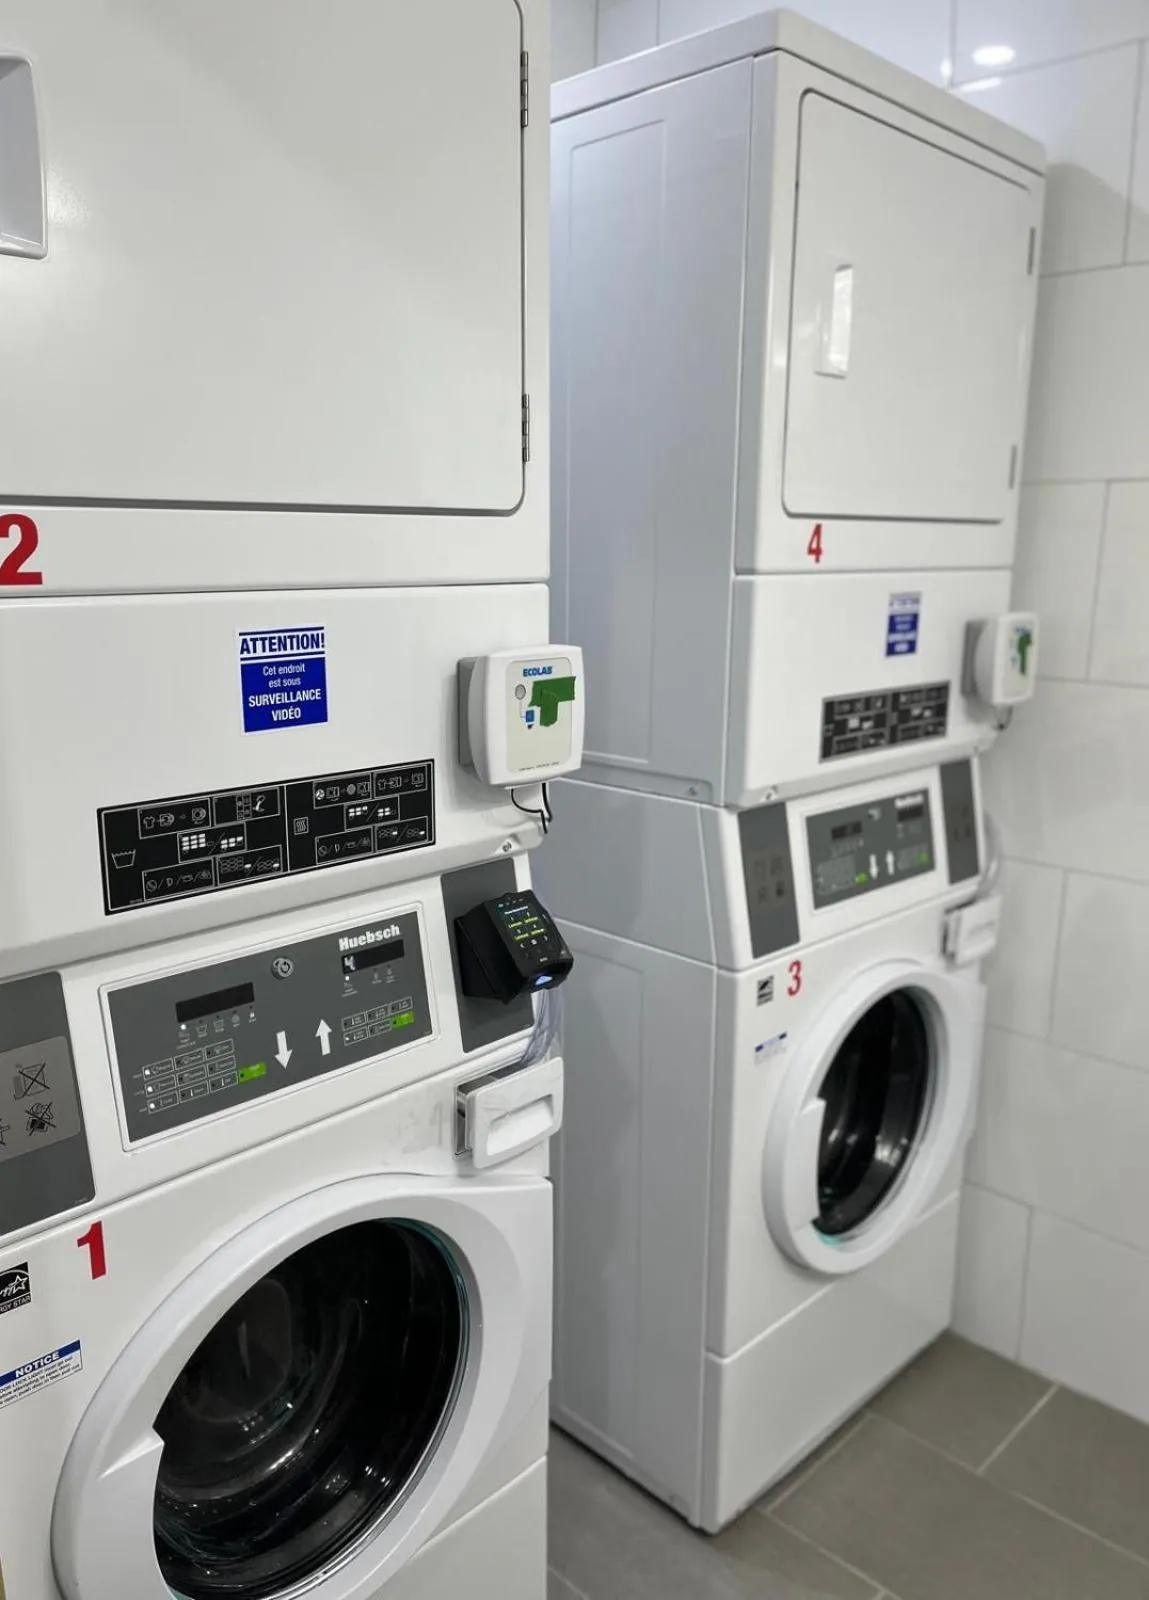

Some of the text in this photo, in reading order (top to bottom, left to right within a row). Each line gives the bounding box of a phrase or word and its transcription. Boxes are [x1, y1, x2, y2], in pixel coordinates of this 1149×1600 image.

[0, 513, 43, 585] 2
[807, 523, 823, 563] 4
[240, 633, 325, 655] ATTENTION!
[263, 663, 306, 676] Cet endroit
[523, 666, 553, 677] ECOLAB
[268, 677, 302, 688] est sous
[248, 688, 321, 708] SURVEILLANCE
[271, 706, 301, 721] VIDÉO
[338, 924, 400, 951] Huebsch
[786, 960, 802, 996] 3
[76, 1220, 106, 1280] 1
[15, 1351, 60, 1378] NOTICE
